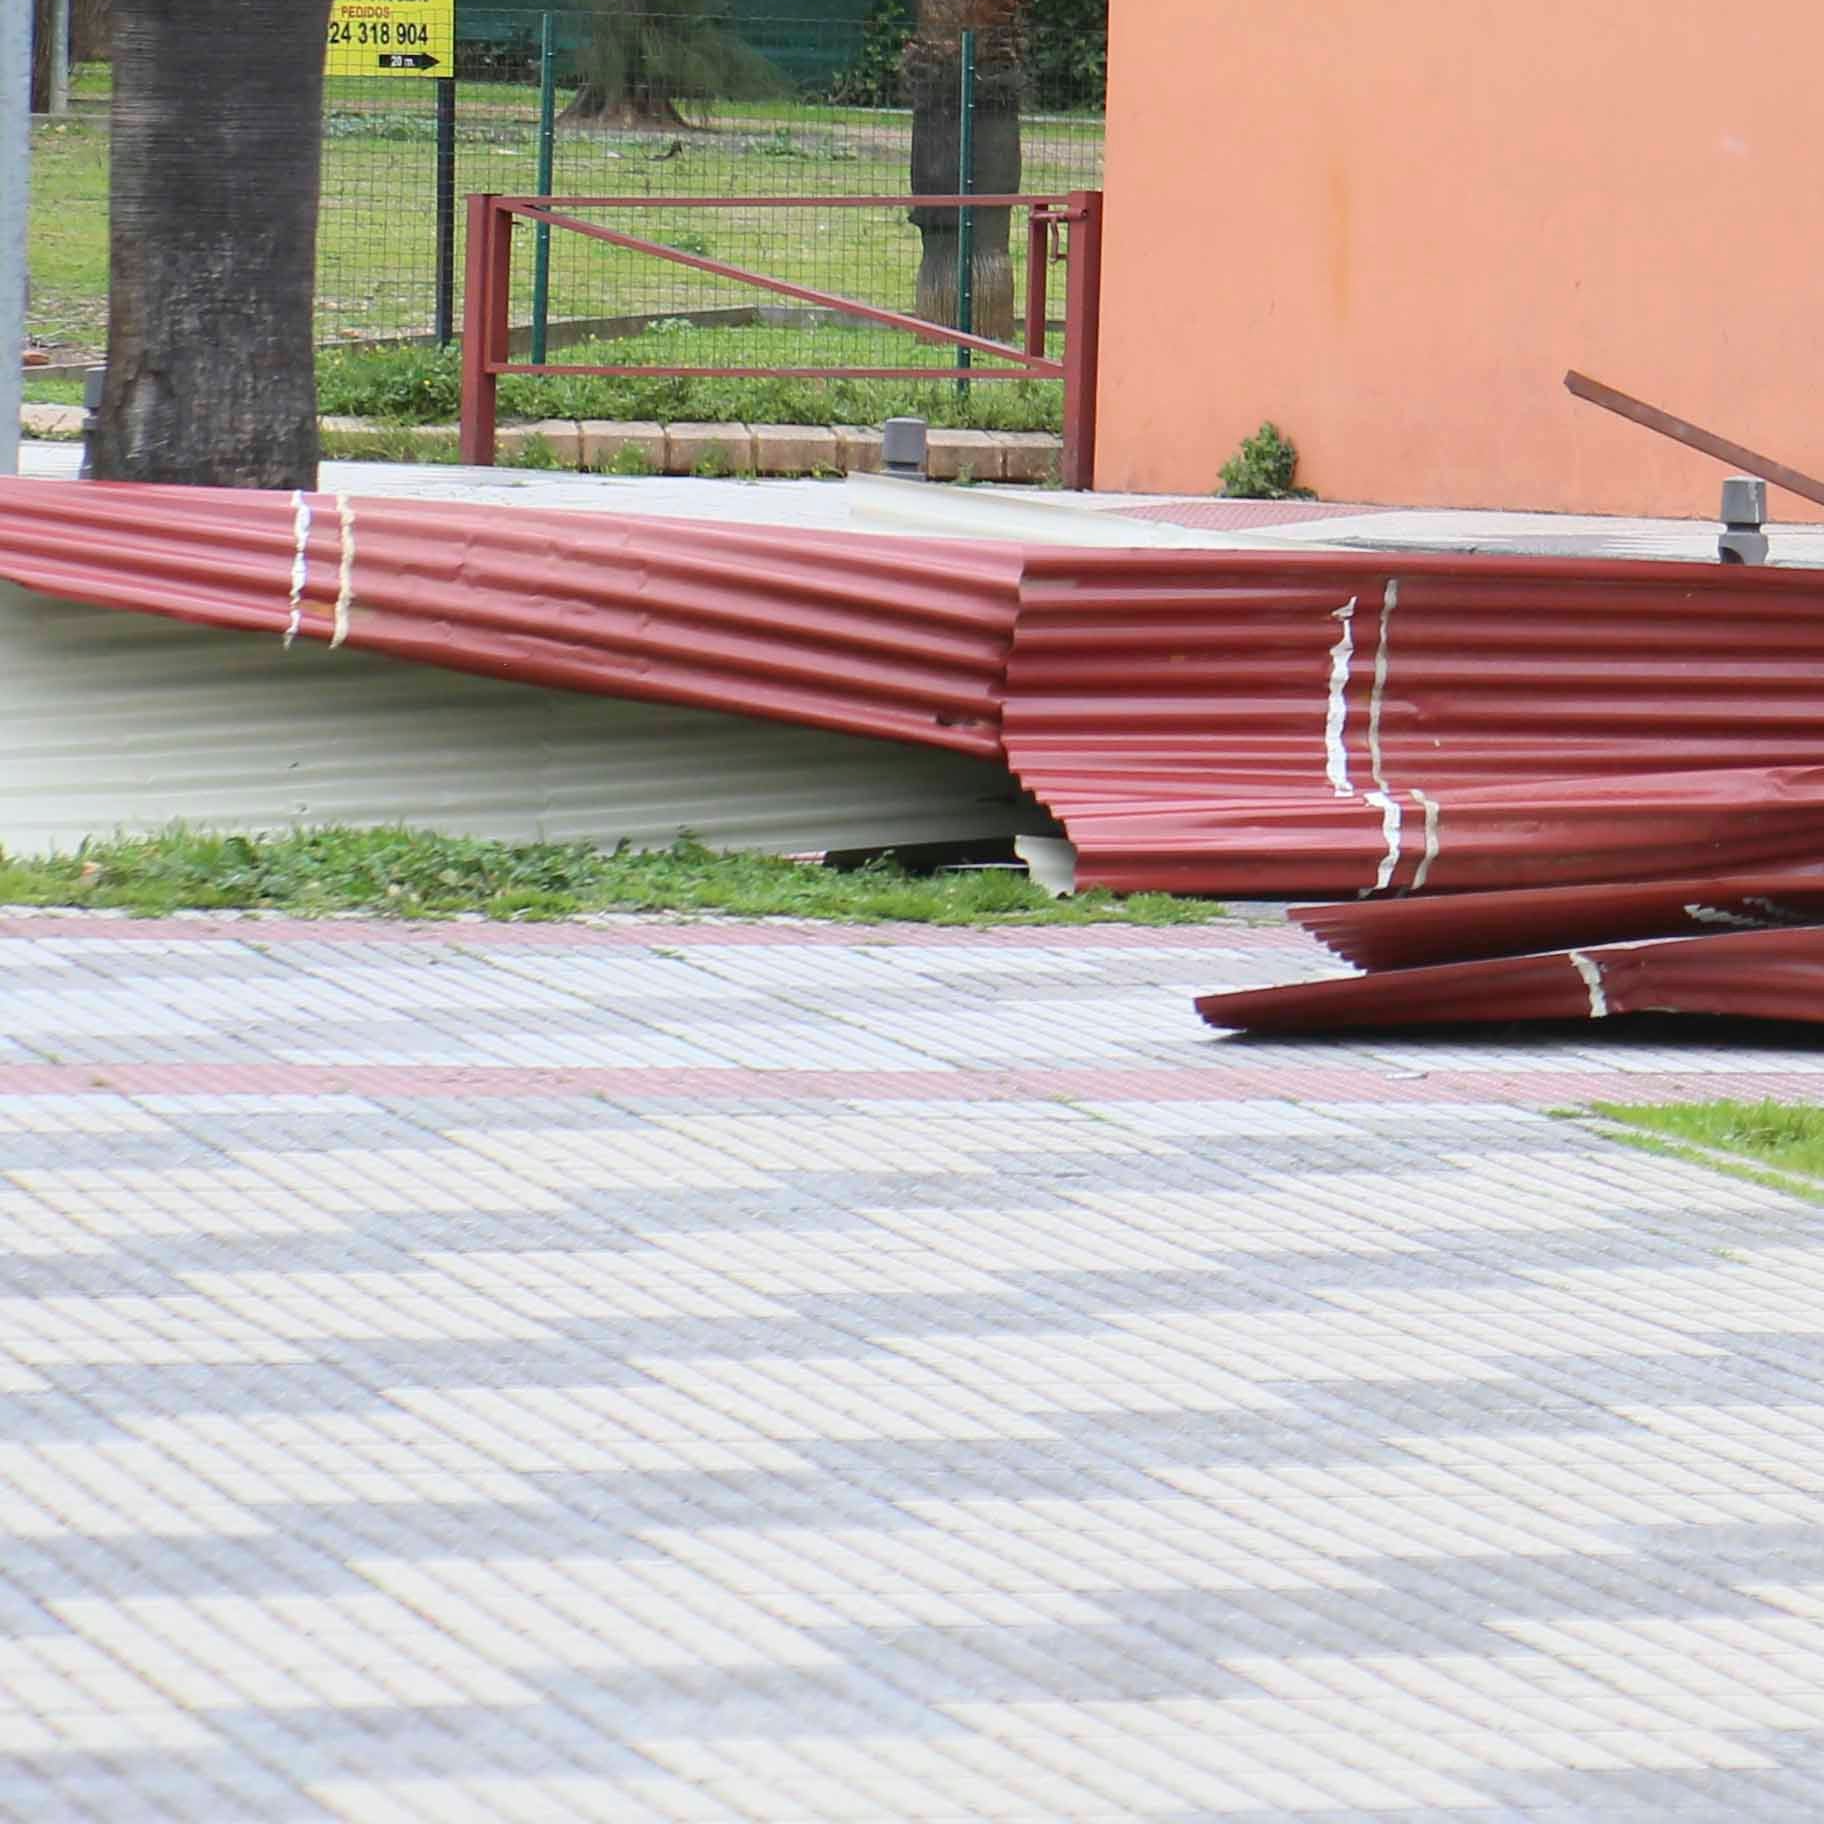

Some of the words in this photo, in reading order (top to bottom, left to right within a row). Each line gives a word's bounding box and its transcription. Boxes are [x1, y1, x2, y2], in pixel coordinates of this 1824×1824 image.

[341, 6, 391, 18] PEDIDOS
[330, 22, 352, 44] 24
[358, 22, 390, 45] 318
[396, 23, 429, 46] 904
